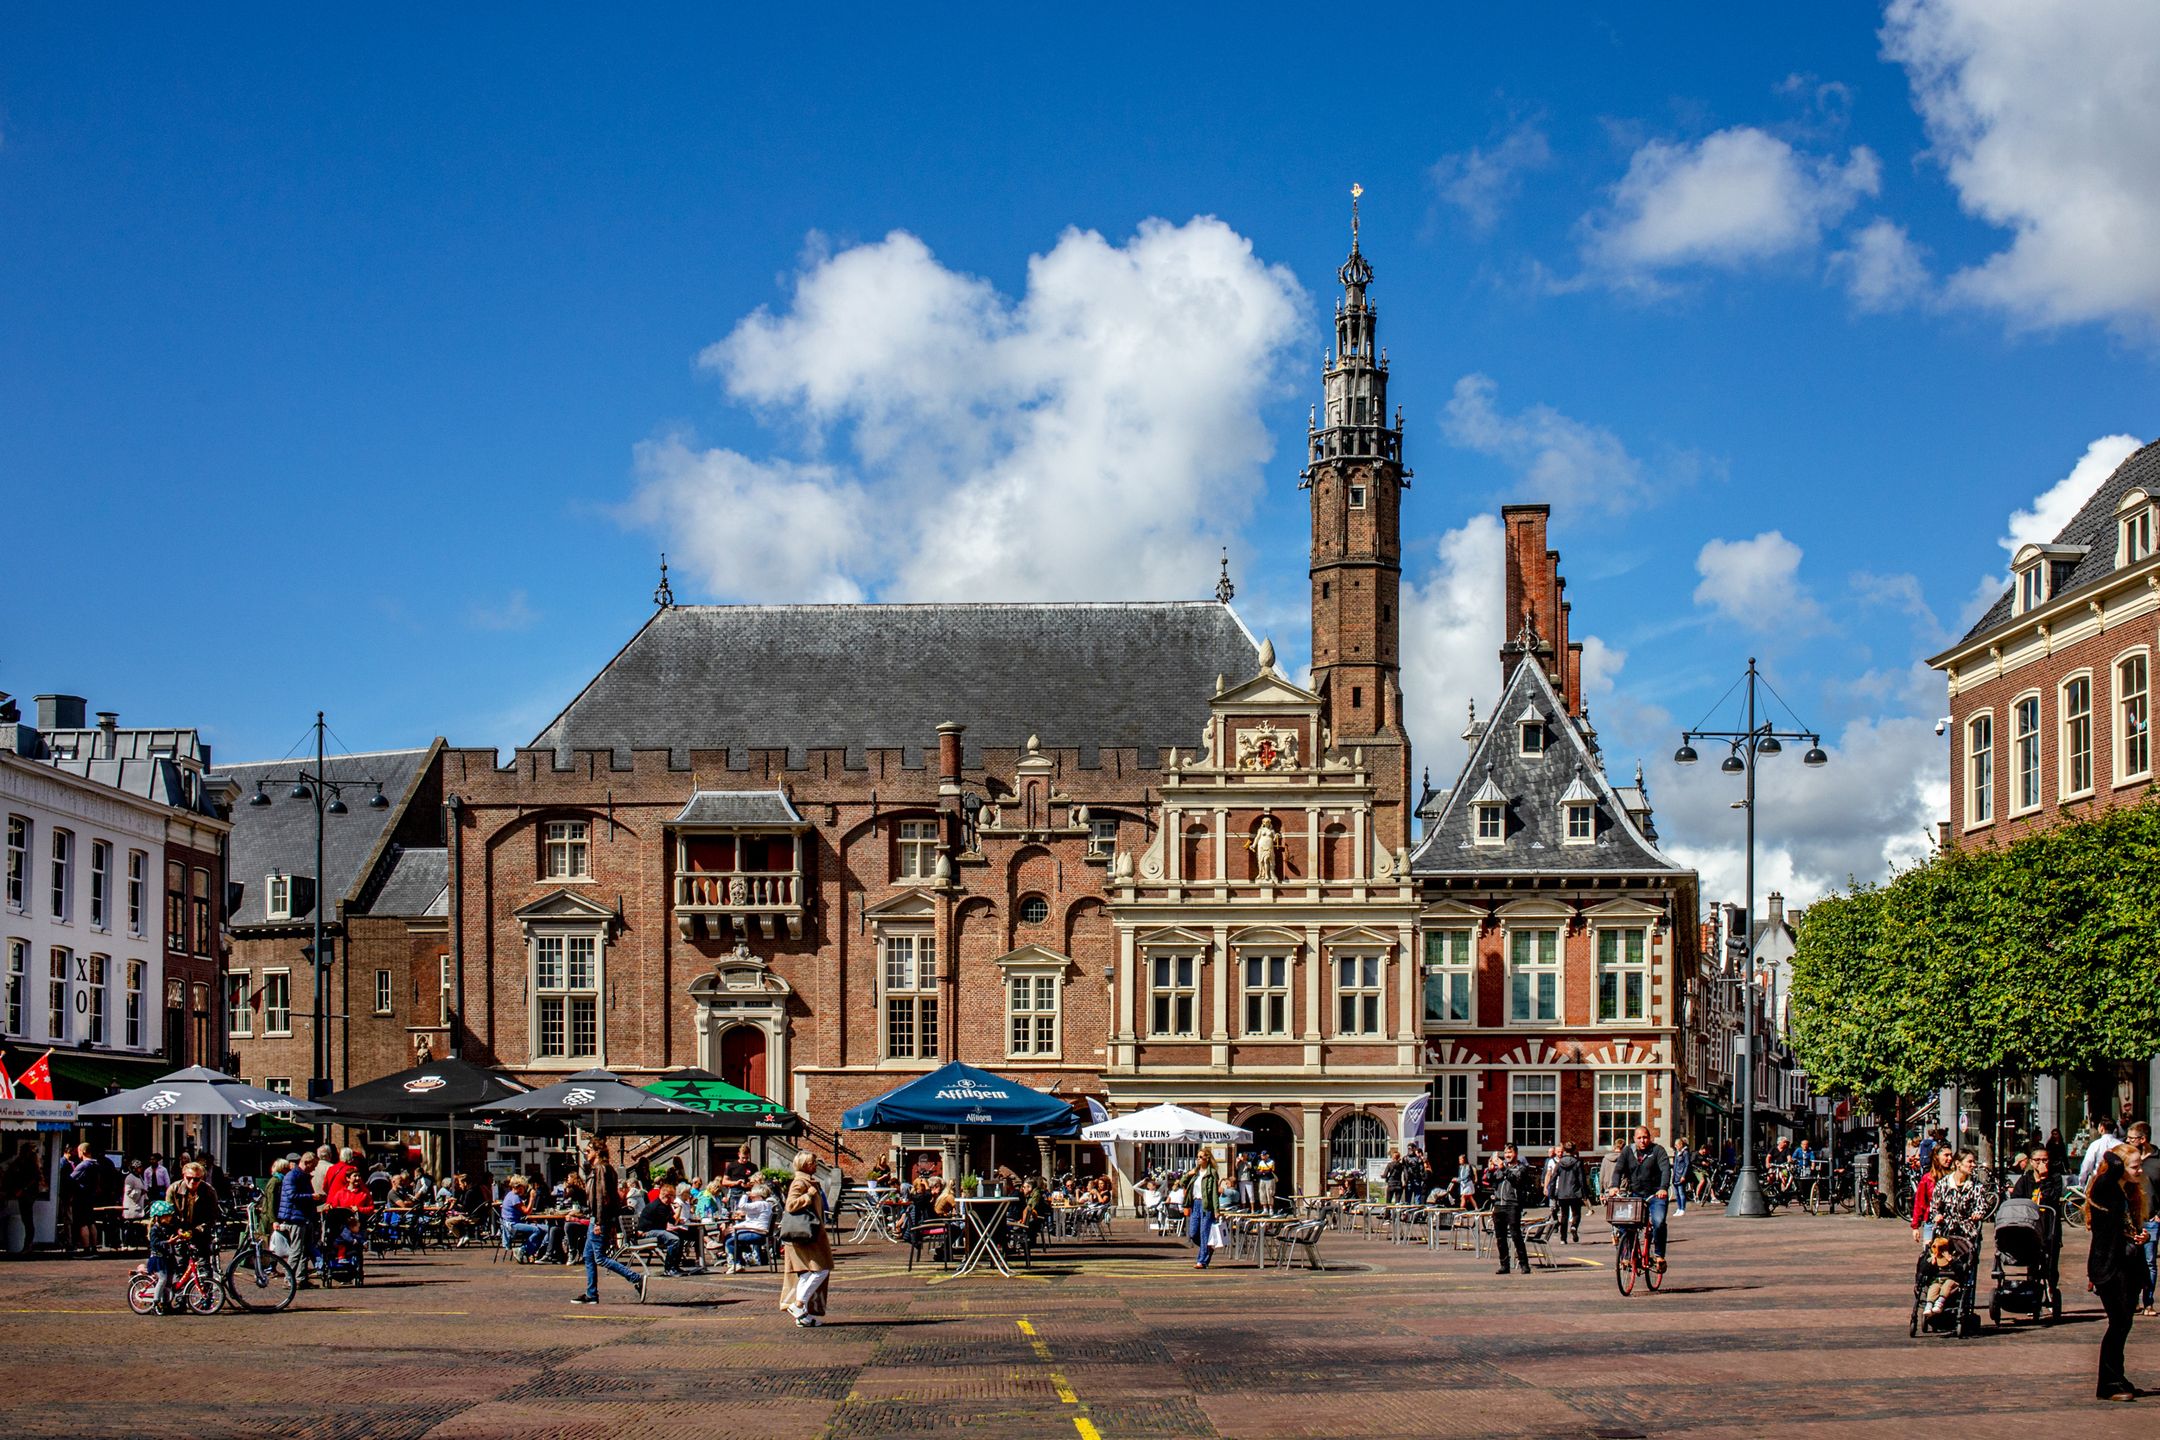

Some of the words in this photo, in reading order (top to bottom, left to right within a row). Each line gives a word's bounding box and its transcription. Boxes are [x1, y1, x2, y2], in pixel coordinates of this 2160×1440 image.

[935, 1088, 1010, 1100] Affligem
[684, 1099, 786, 1113] eken
[965, 1113, 993, 1123] Affligem
[1094, 1130, 1111, 1138] VELTINS
[1140, 1130, 1170, 1138] VELTINS
[1203, 1131, 1231, 1140] VELTINS
